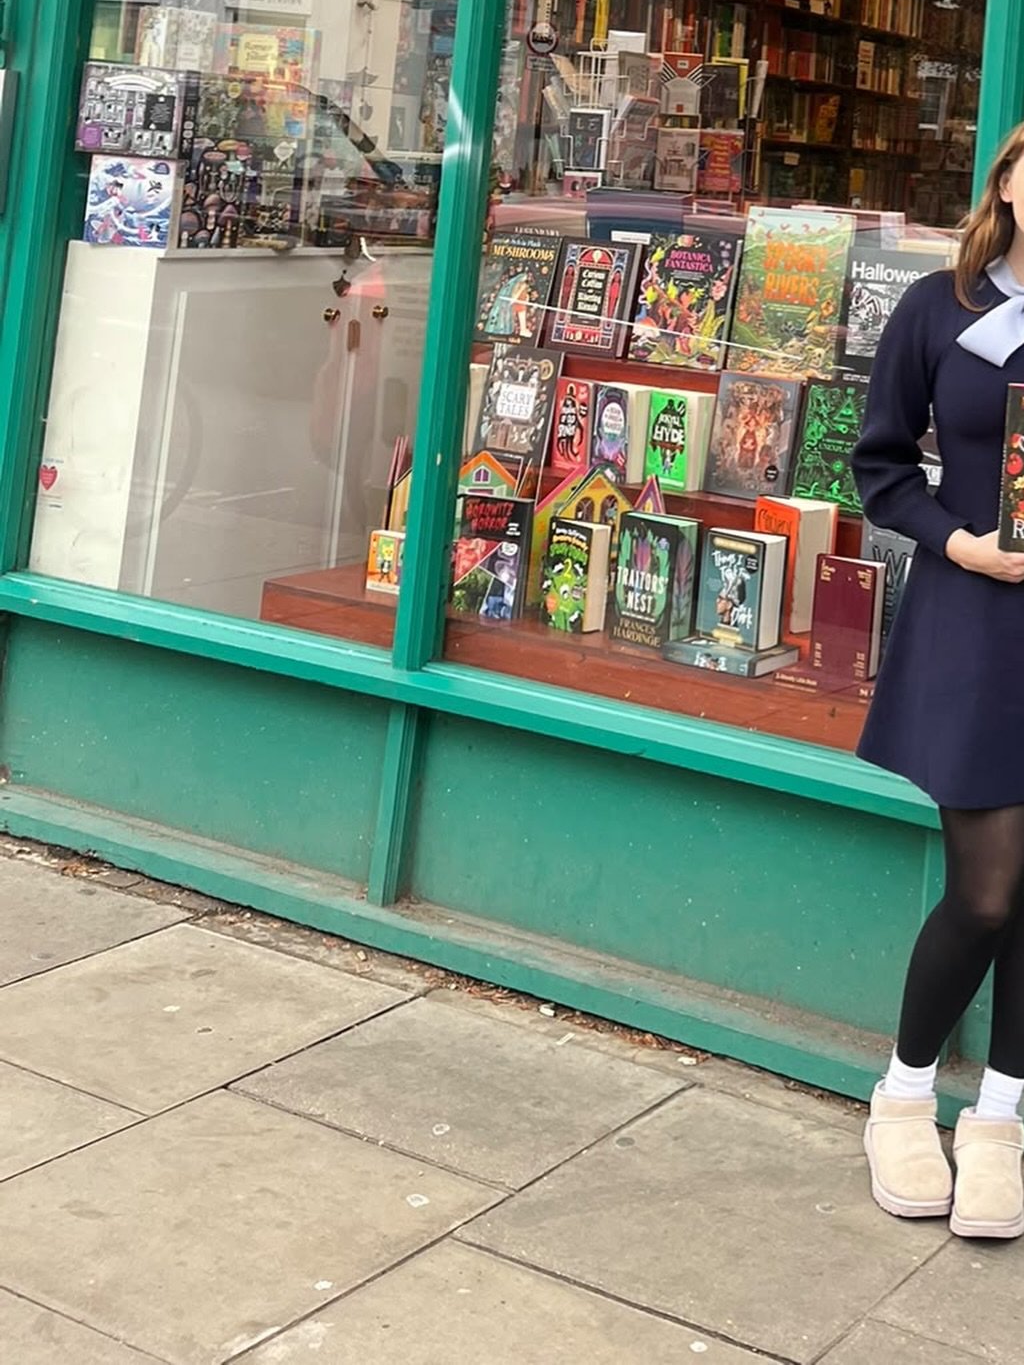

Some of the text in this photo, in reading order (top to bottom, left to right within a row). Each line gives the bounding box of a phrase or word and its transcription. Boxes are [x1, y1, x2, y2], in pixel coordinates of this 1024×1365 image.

[493, 244, 555, 261] MUSHROOMS
[670, 250, 711, 263] BOTANICA
[664, 259, 713, 273] FANTASTICA
[501, 389, 532, 405] SCARY
[499, 403, 530, 418] TALES
[653, 425, 685, 445] HYDE
[563, 558, 572, 579] 2
[616, 566, 669, 595] TRAITORS'
[626, 590, 653, 615] NEST
